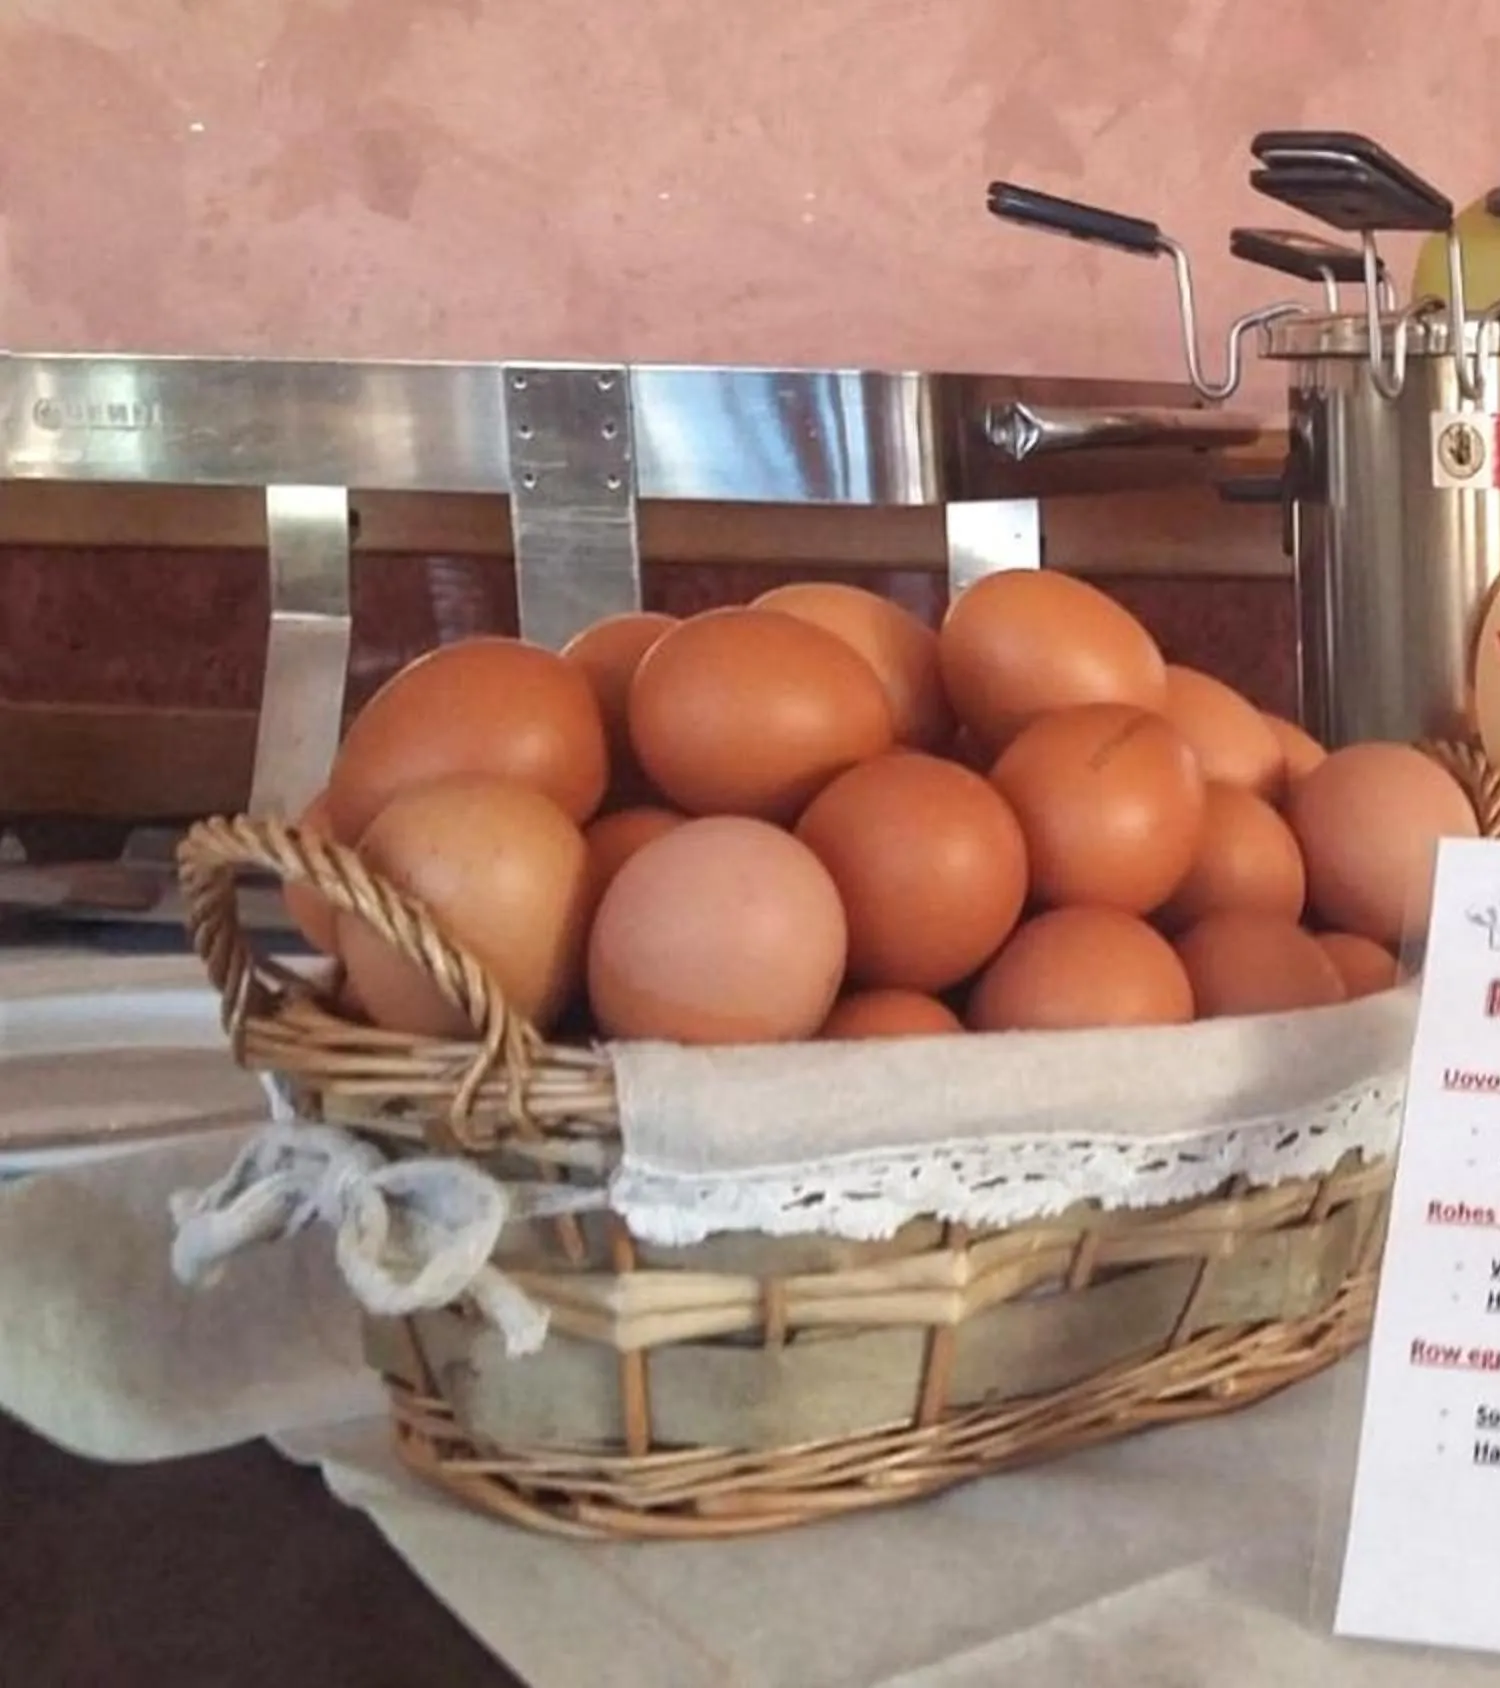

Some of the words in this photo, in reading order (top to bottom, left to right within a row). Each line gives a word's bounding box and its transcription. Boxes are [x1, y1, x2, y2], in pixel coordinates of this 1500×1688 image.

[1443, 1068, 1500, 1091] Uovo
[1427, 1201, 1495, 1225] Rohes
[1410, 1339, 1461, 1364] Row
